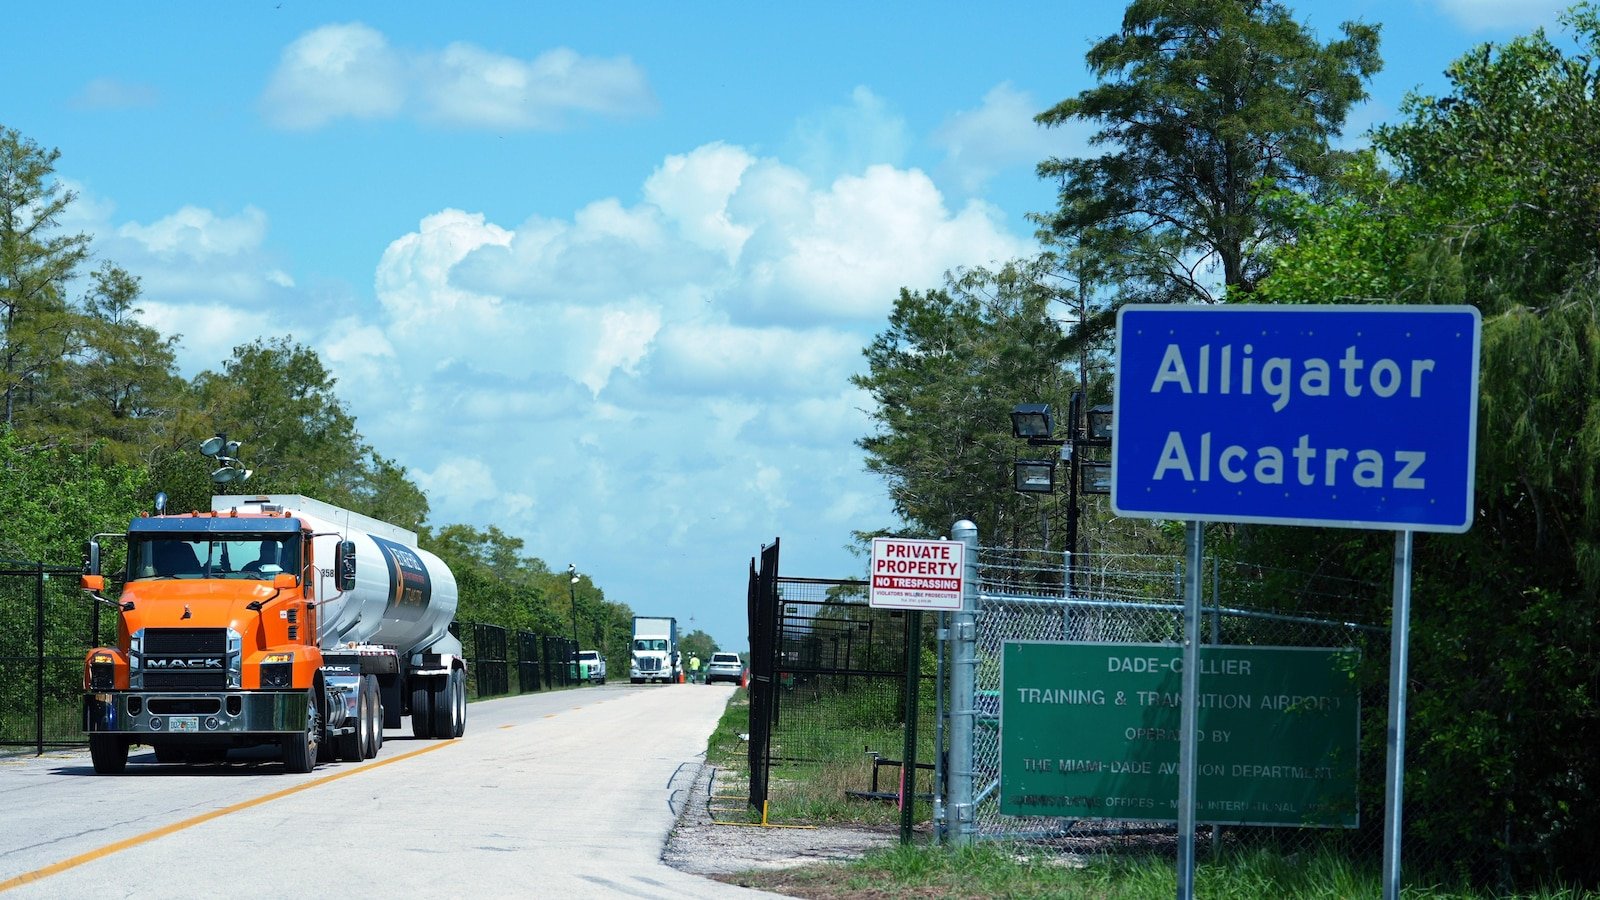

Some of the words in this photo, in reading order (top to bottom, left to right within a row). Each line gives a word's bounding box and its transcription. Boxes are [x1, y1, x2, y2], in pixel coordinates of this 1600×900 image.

[1150, 343, 1436, 413] Alligator
[1152, 431, 1427, 490] Alcatraz
[886, 544, 950, 560] PRIVATE
[320, 568, 335, 578] 358
[877, 559, 958, 576] PROPERTY
[876, 577, 890, 587] NO
[892, 578, 958, 590] TRESPASSING
[147, 658, 223, 668] MACK
[1107, 656, 1252, 676] DADE-CLLIER
[1017, 687, 1105, 706] TRAINING
[1114, 690, 1127, 706] &
[1136, 691, 1252, 709] TRANITION
[1212, 729, 1232, 743] BY
[1023, 758, 1052, 771] THE
[1058, 759, 1151, 774] MIAMI-DADE
[1158, 762, 1225, 777] AVIION
[1232, 765, 1333, 780] DEPARTMENT
[1105, 796, 1154, 809] OFFICES
